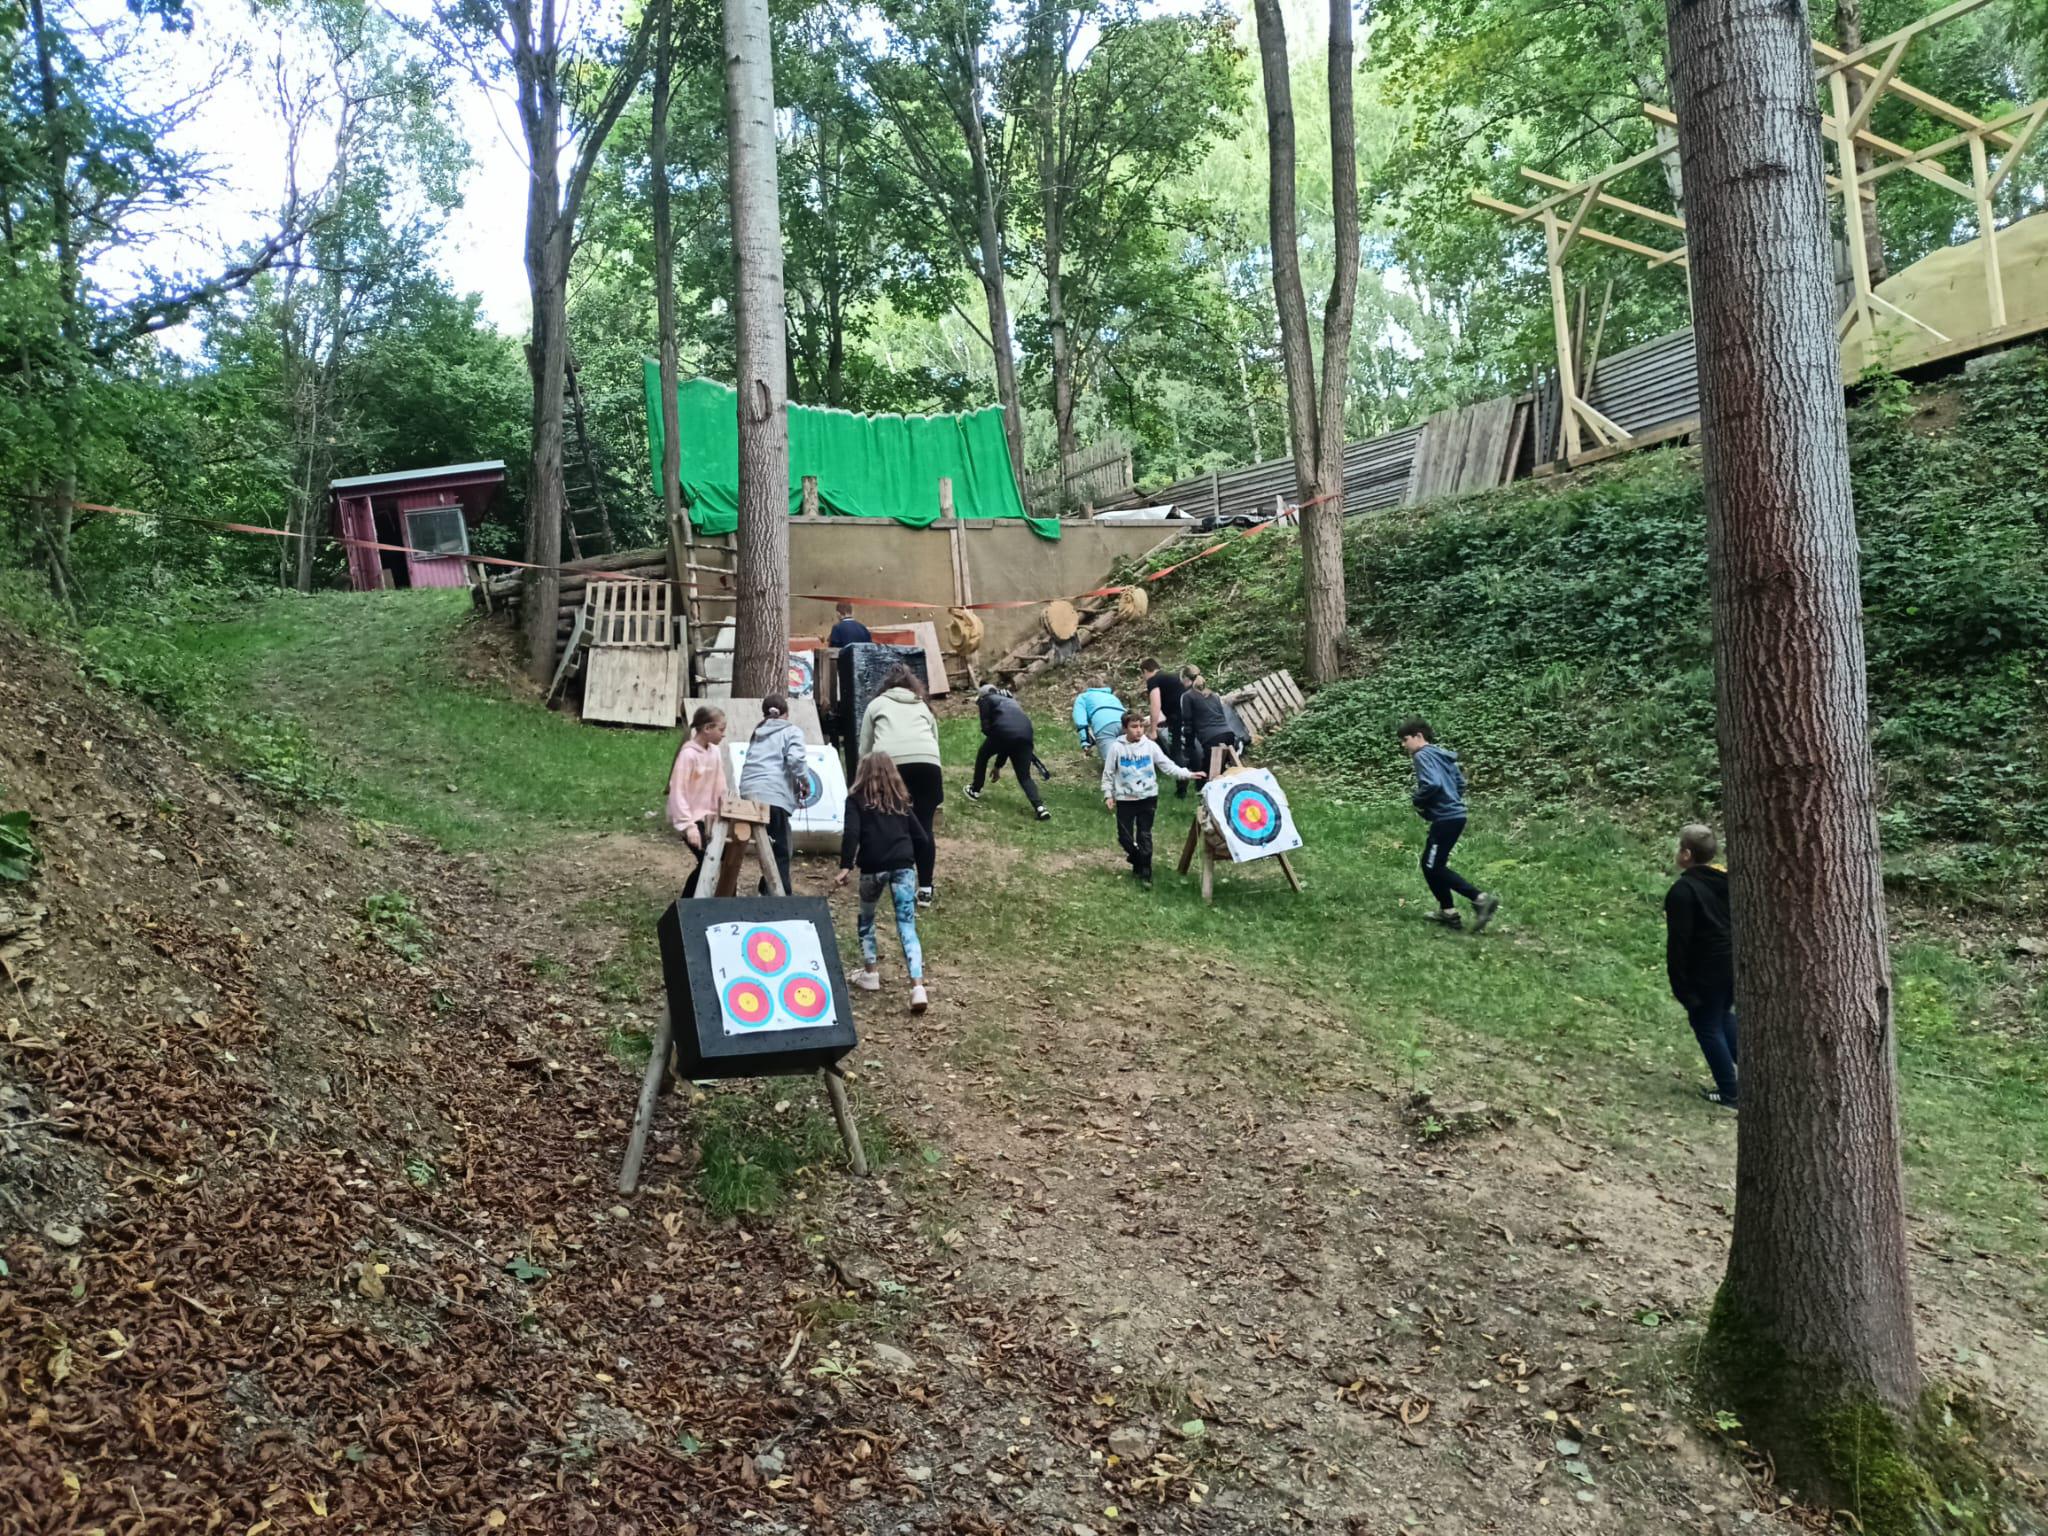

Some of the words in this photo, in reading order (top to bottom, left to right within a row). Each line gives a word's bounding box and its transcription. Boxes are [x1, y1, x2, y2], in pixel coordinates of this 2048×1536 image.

[730, 923, 740, 936] 2
[810, 960, 820, 971] 3
[719, 967, 726, 979] 1
